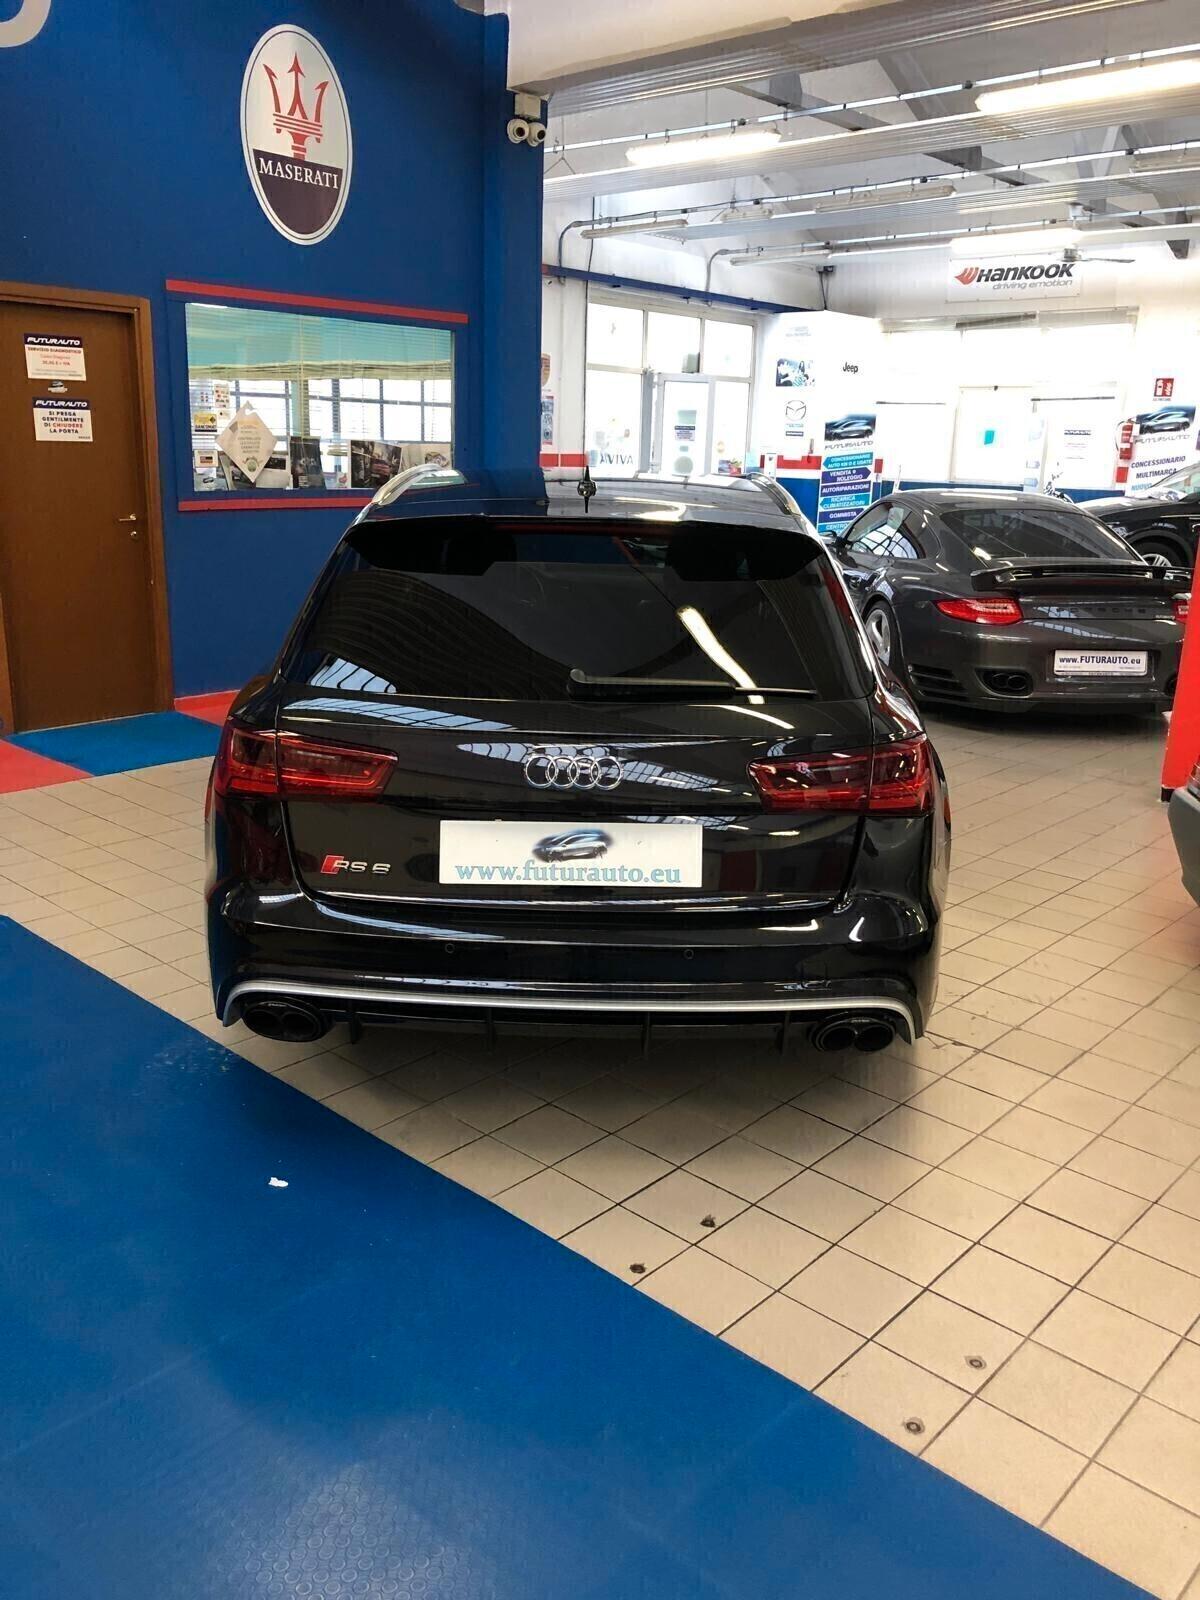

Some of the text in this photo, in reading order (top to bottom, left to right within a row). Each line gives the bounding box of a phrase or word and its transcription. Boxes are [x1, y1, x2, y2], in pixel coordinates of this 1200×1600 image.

[258, 157, 339, 189] MASERATI
[992, 279, 1073, 291] driving emotion
[27, 336, 80, 346] FUTURAUTO
[842, 361, 859, 374] Jeep
[35, 399, 88, 408] FUTURAUTO
[1131, 455, 1186, 468] CONCESSIONARIO
[829, 469, 852, 477] VENDITA
[1136, 468, 1177, 479] MULTIMARCA
[1059, 655, 1141, 664] www.FUTURAUTO.eu
[455, 859, 681, 883] www.futurauto.eu
